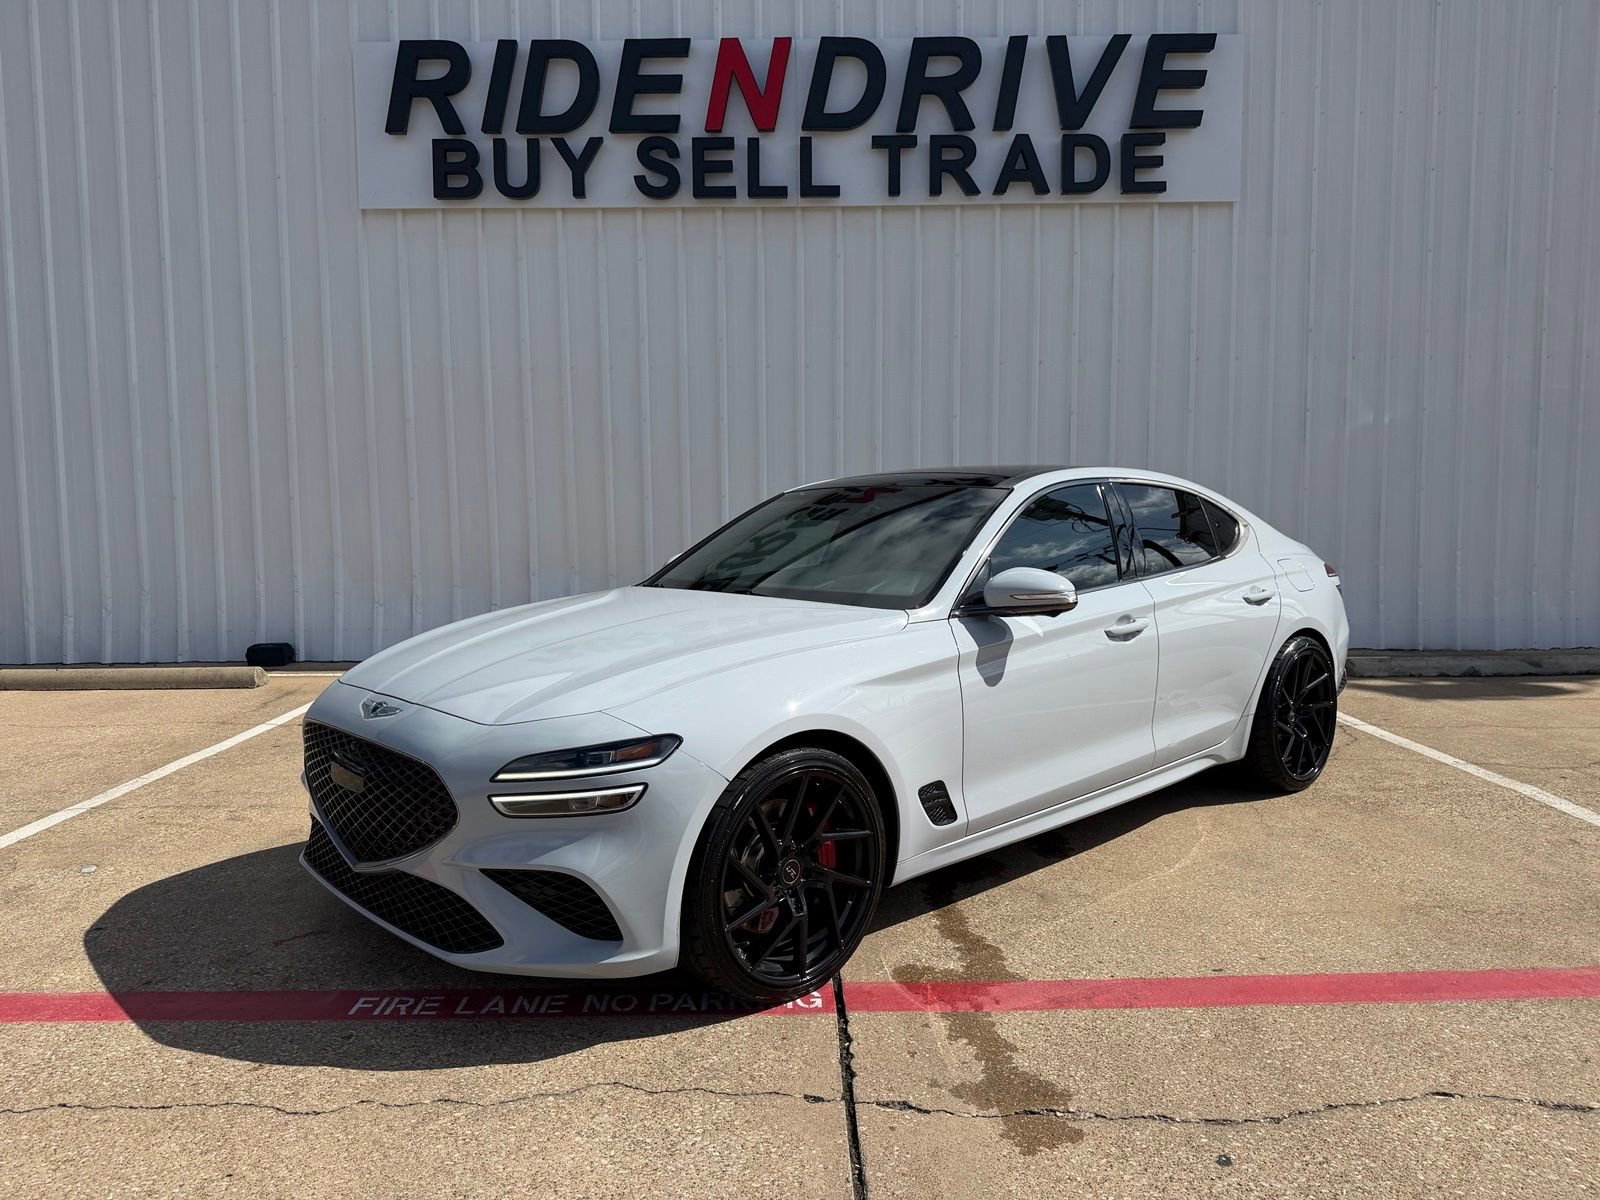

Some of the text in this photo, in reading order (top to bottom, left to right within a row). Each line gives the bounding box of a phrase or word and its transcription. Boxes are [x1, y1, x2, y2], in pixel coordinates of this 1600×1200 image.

[385, 33, 1217, 135] RIDENDRIVE
[432, 133, 1167, 200] BUY SELL TRADE
[347, 991, 823, 1016] FIRE LANE NO PARKG
